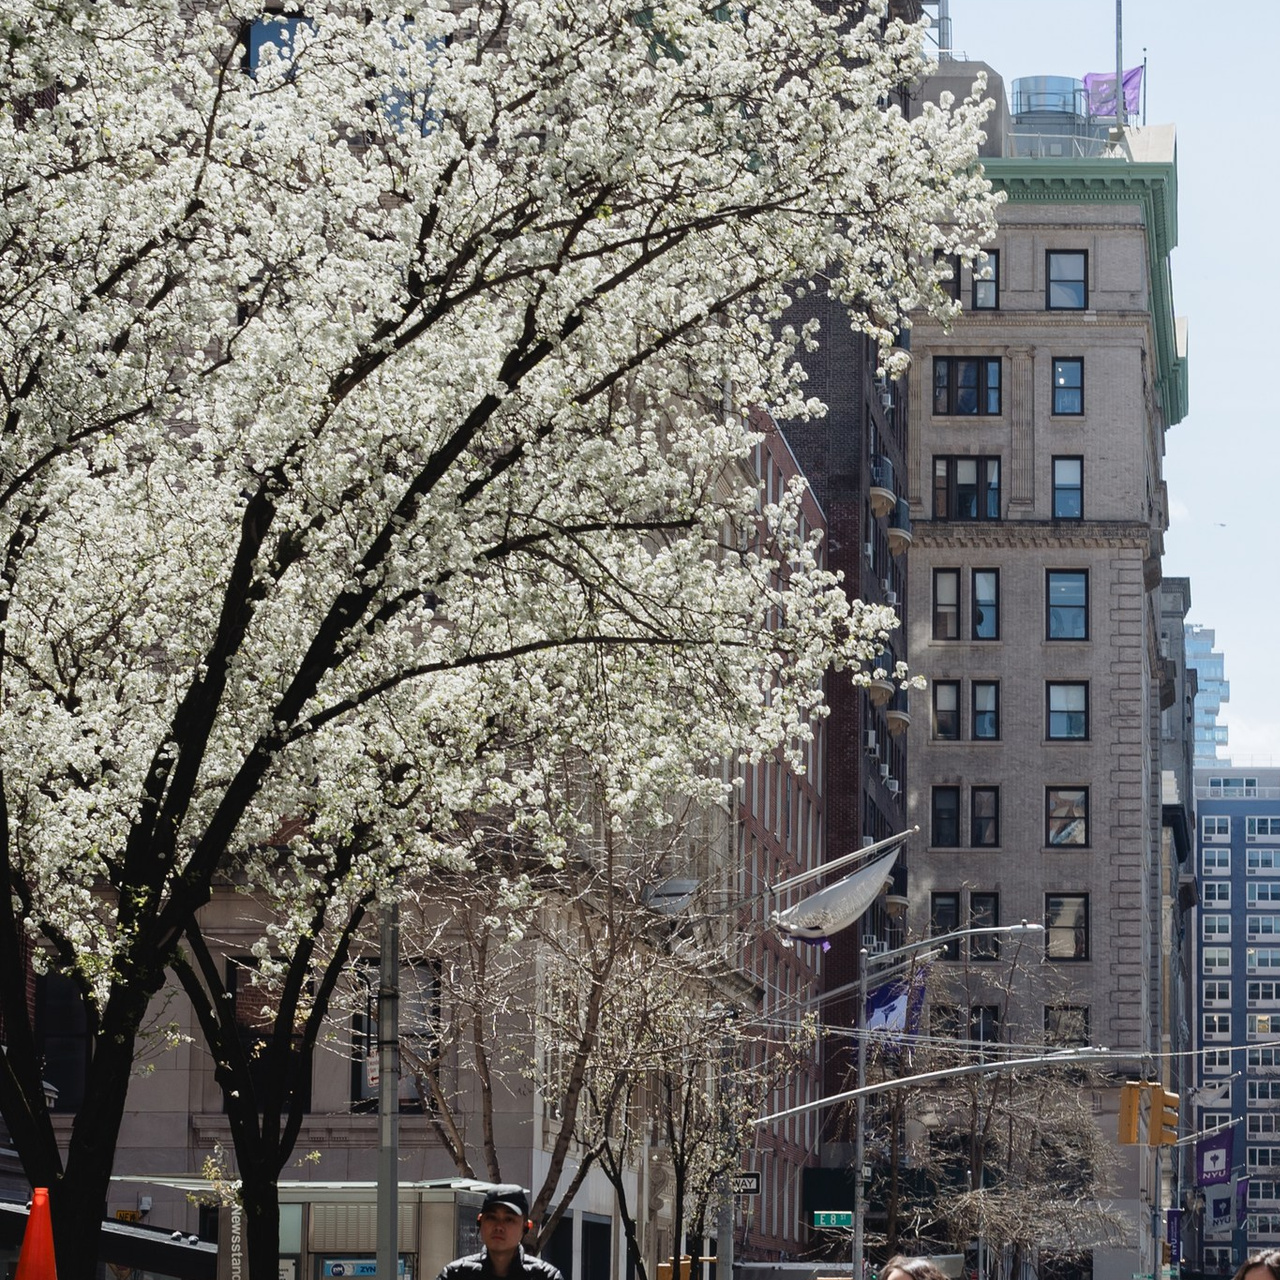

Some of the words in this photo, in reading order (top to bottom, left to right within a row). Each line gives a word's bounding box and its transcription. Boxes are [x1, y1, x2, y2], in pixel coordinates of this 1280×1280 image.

[1202, 1170, 1226, 1179] NYU
[820, 1214, 826, 1225] E
[830, 1214, 837, 1225] 8
[1212, 1217, 1231, 1227] NYU
